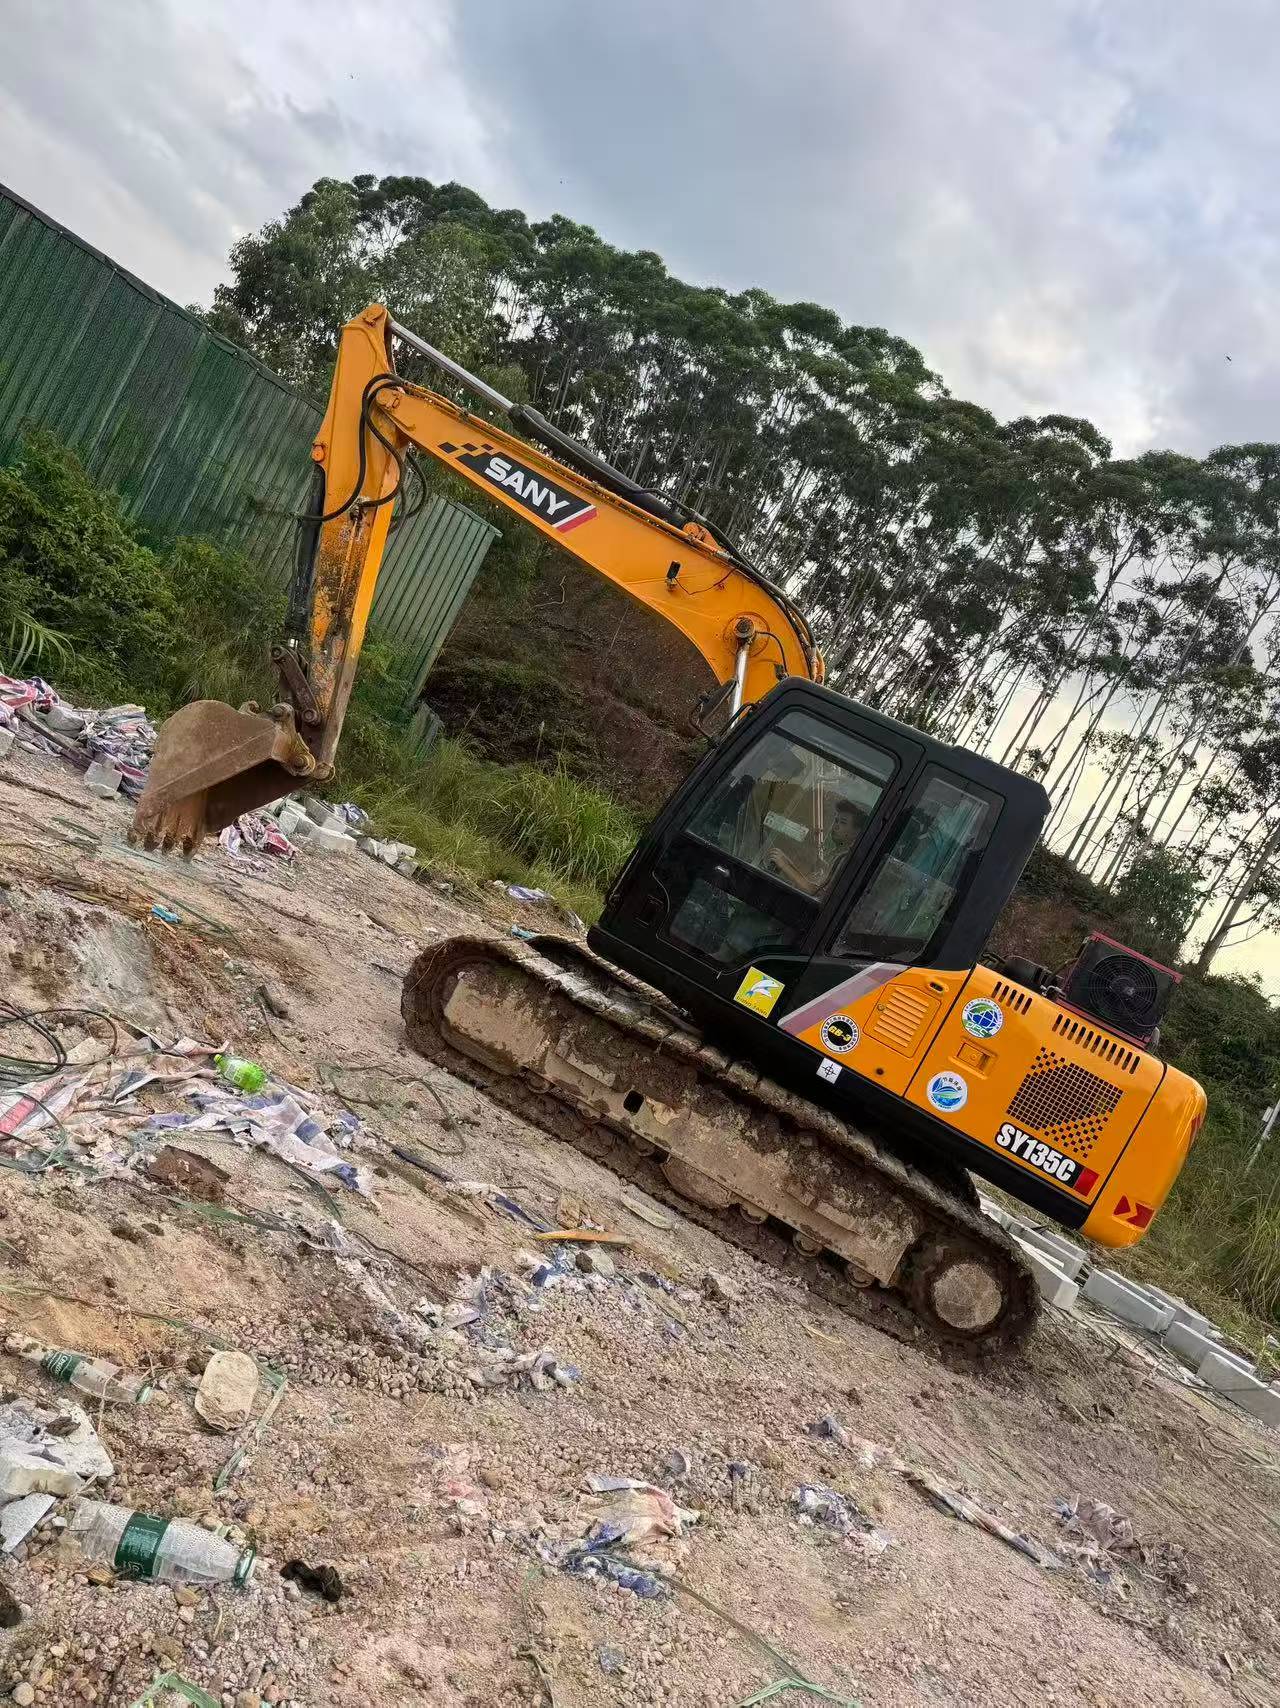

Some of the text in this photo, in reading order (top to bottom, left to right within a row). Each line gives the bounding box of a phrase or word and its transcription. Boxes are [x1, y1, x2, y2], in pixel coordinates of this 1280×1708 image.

[484, 457, 570, 516] SANY
[828, 1025, 851, 1042] GB-3
[996, 1123, 1076, 1182] SY135C
